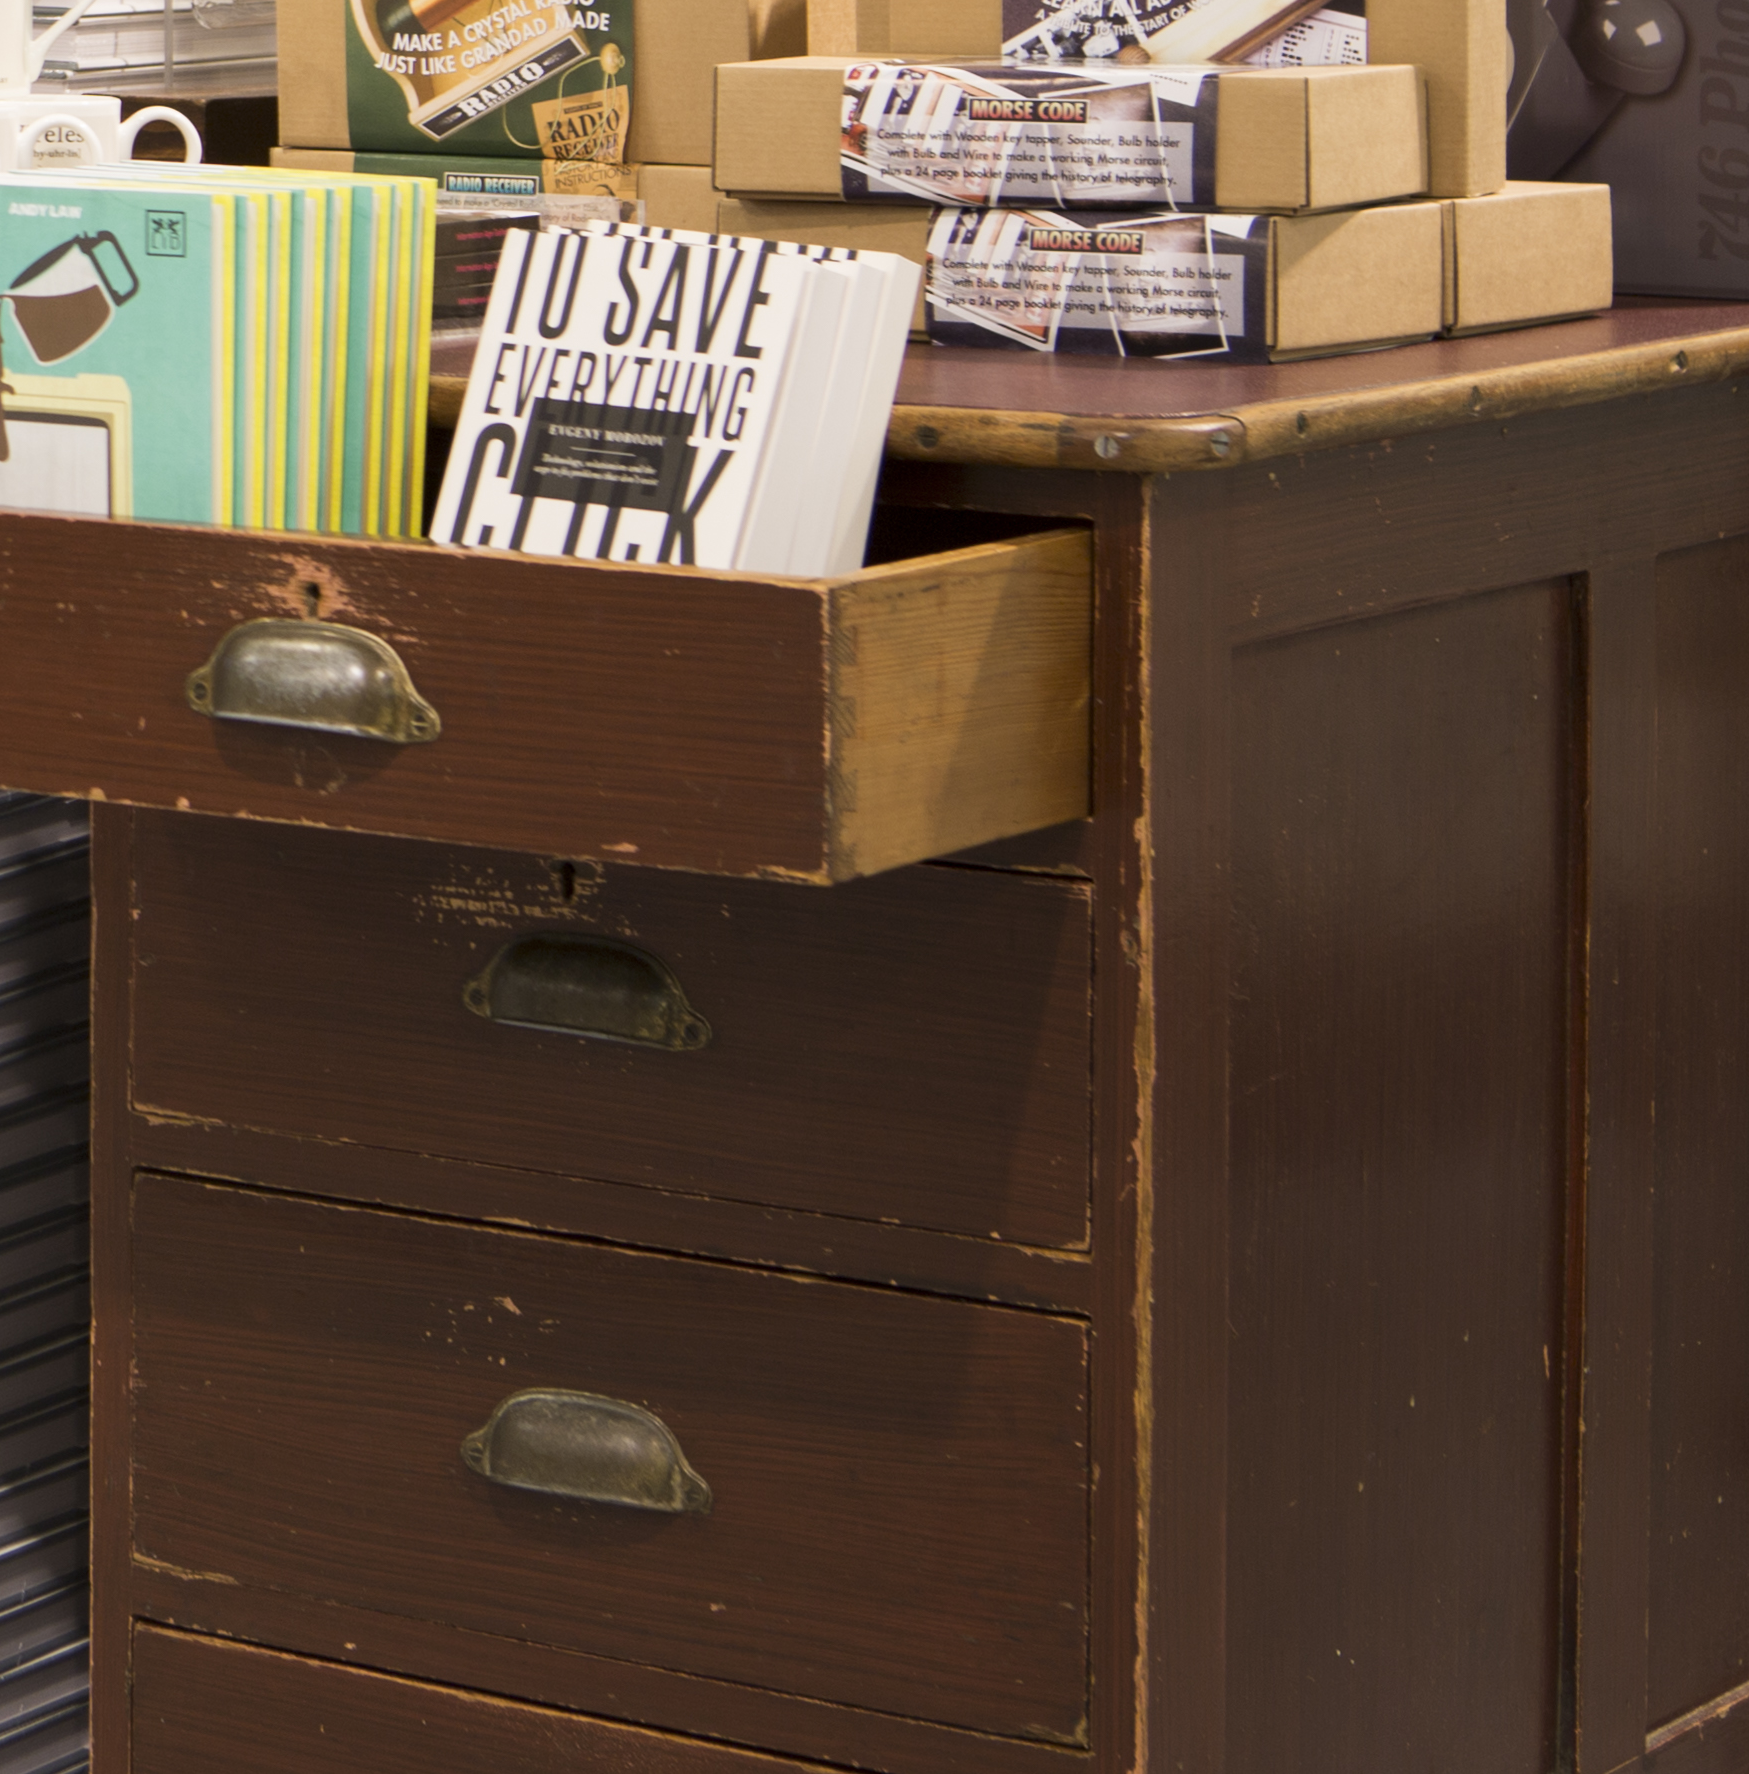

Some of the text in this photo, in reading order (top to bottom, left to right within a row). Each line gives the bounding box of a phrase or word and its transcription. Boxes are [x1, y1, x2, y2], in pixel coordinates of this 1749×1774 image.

[373, 10, 611, 76] JUST LIKE GRANDAD MADE
[392, 31, 443, 53] MAKE
[447, 29, 462, 49] A
[463, 0, 532, 43] CRYSTAL
[457, 60, 545, 119] RADIO
[971, 99, 1085, 122] MORSE CODE
[547, 107, 621, 144] RADIO
[877, 129, 926, 142] Complete
[929, 129, 952, 142] with
[954, 130, 1000, 143] Wooden
[1003, 131, 1022, 146] key
[1118, 135, 1142, 147] Bulb
[1145, 135, 1181, 149] holder
[447, 176, 536, 195] RADIO RECEIVER
[8, 201, 83, 219] ANDY LAW
[602, 239, 775, 359] SAVE
[484, 341, 756, 443] EVERYTHING
